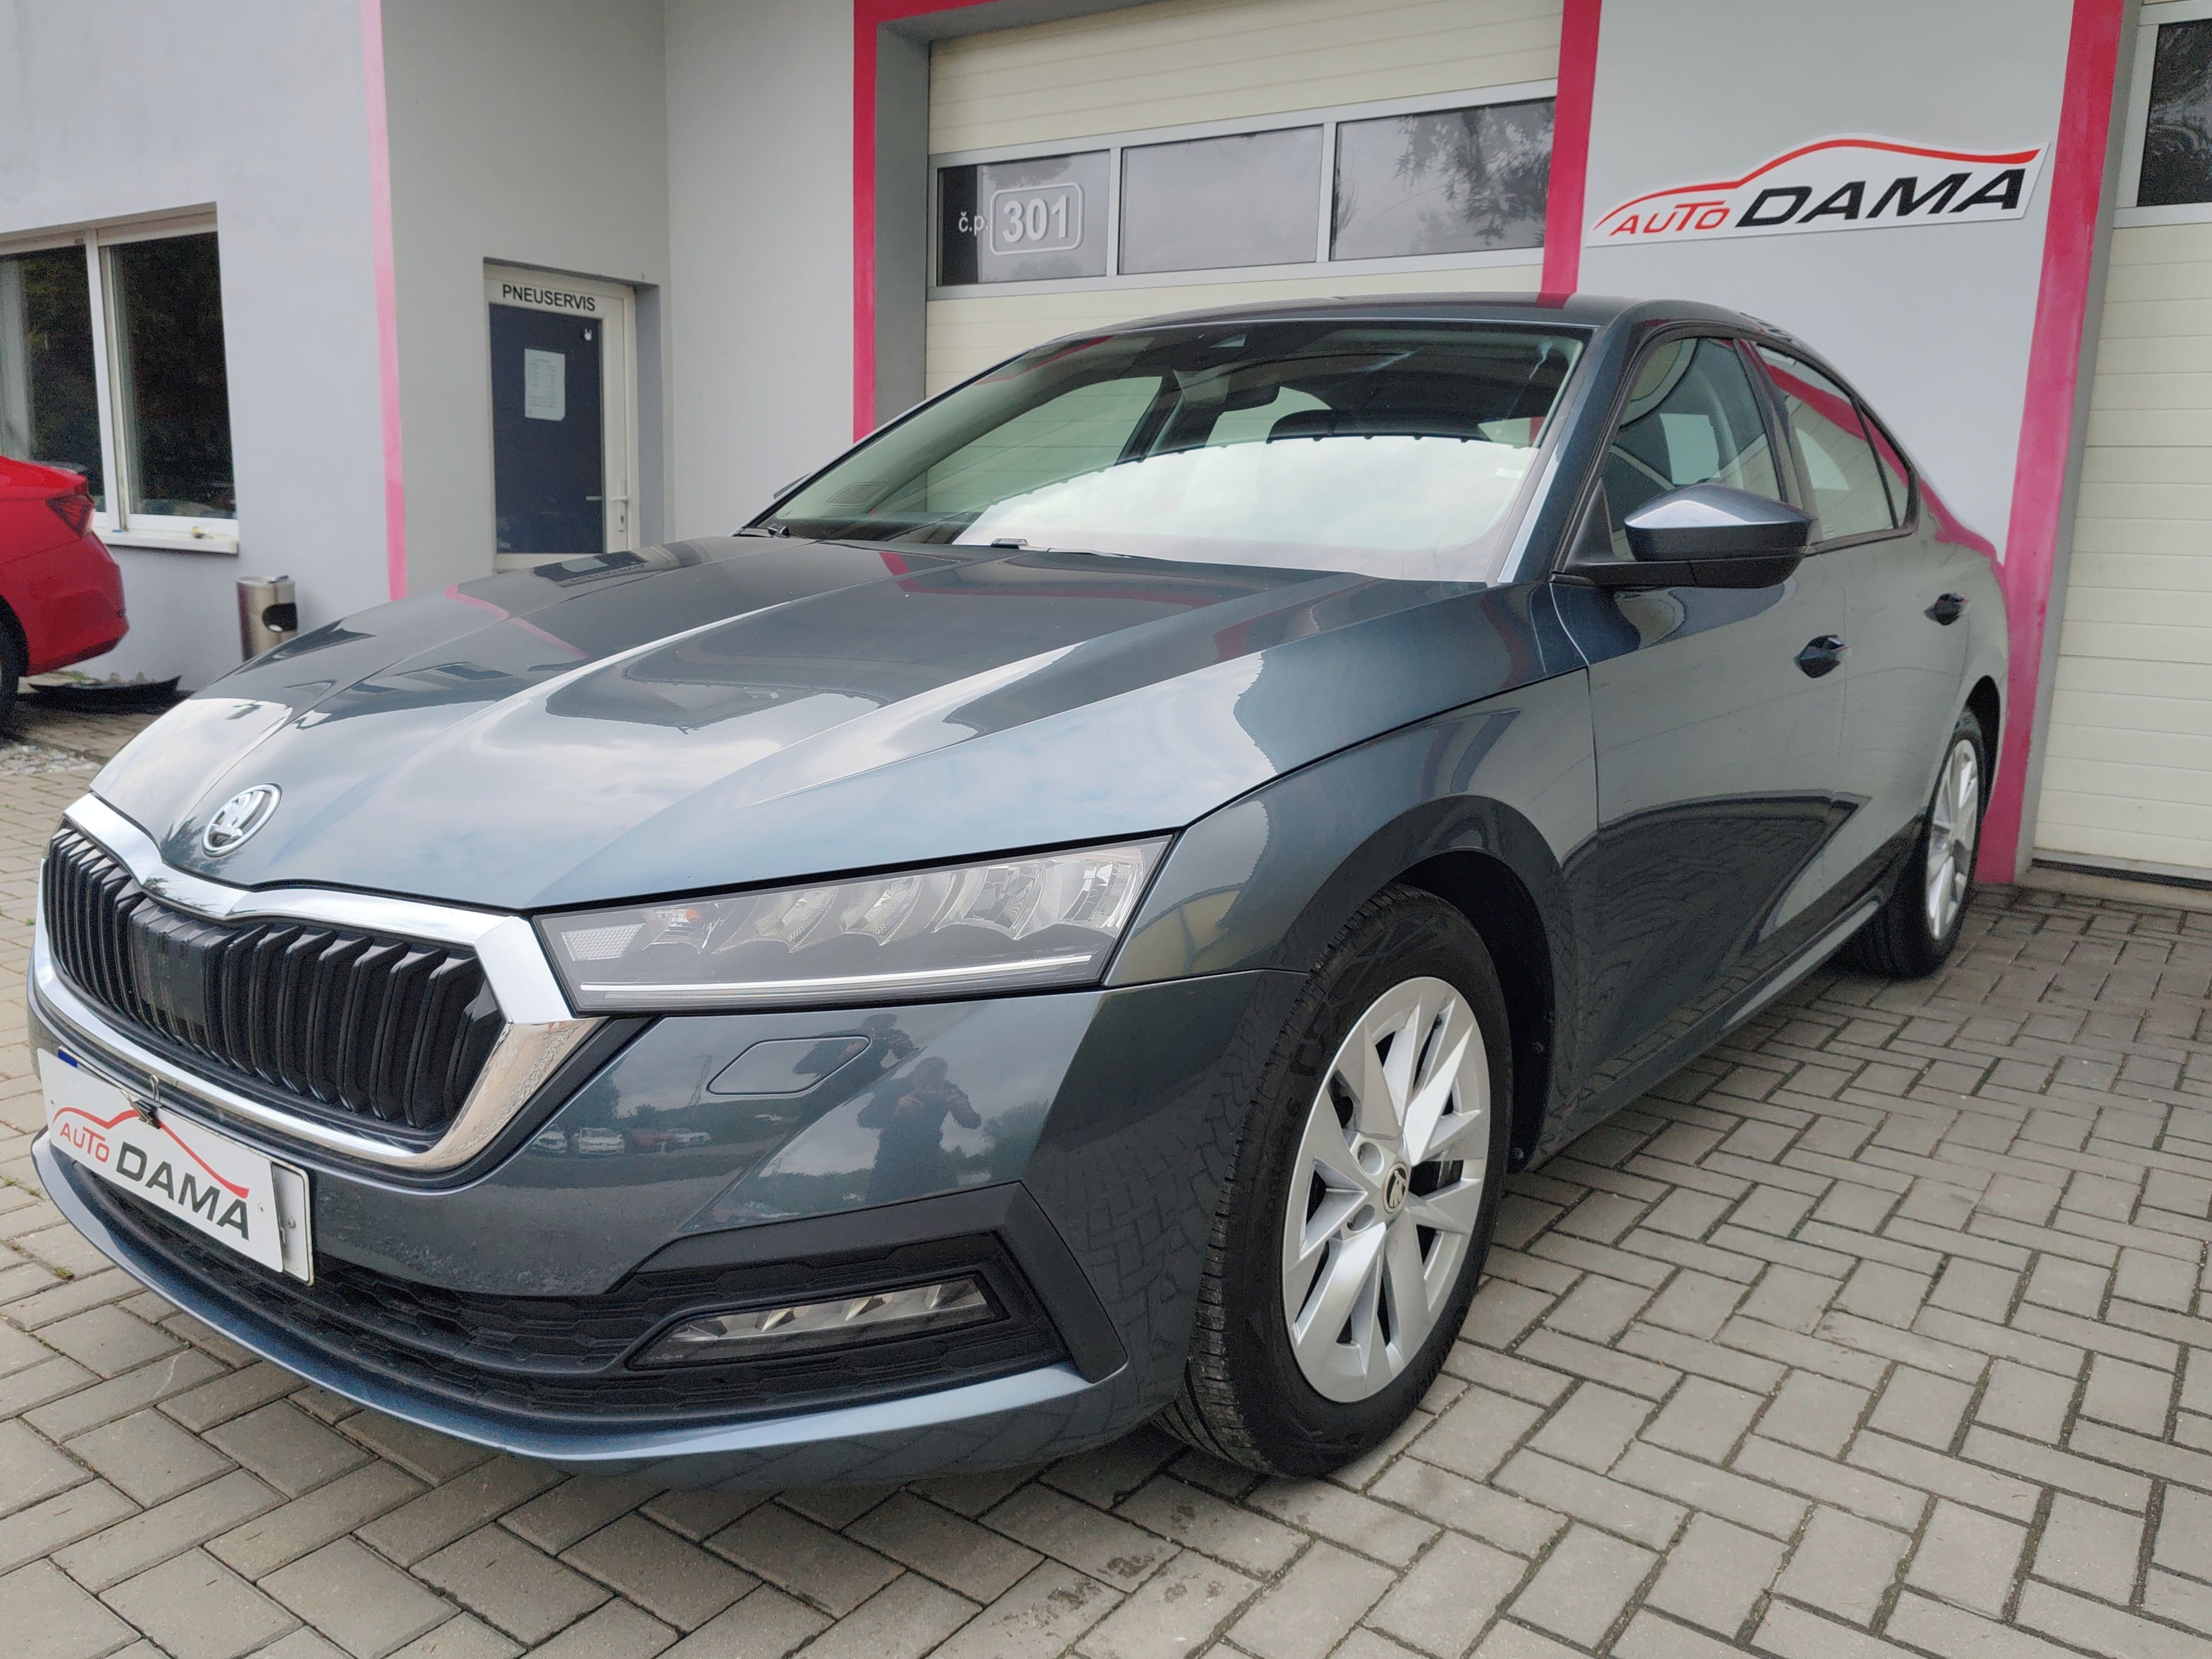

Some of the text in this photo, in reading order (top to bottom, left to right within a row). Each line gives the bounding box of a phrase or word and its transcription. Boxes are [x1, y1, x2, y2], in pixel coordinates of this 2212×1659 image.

[1003, 194, 1068, 243] 301
[1609, 168, 2026, 236] AUTO DAMA
[502, 283, 596, 312] PNEUSERVIS
[60, 1122, 250, 1241] AUTO DAMA
